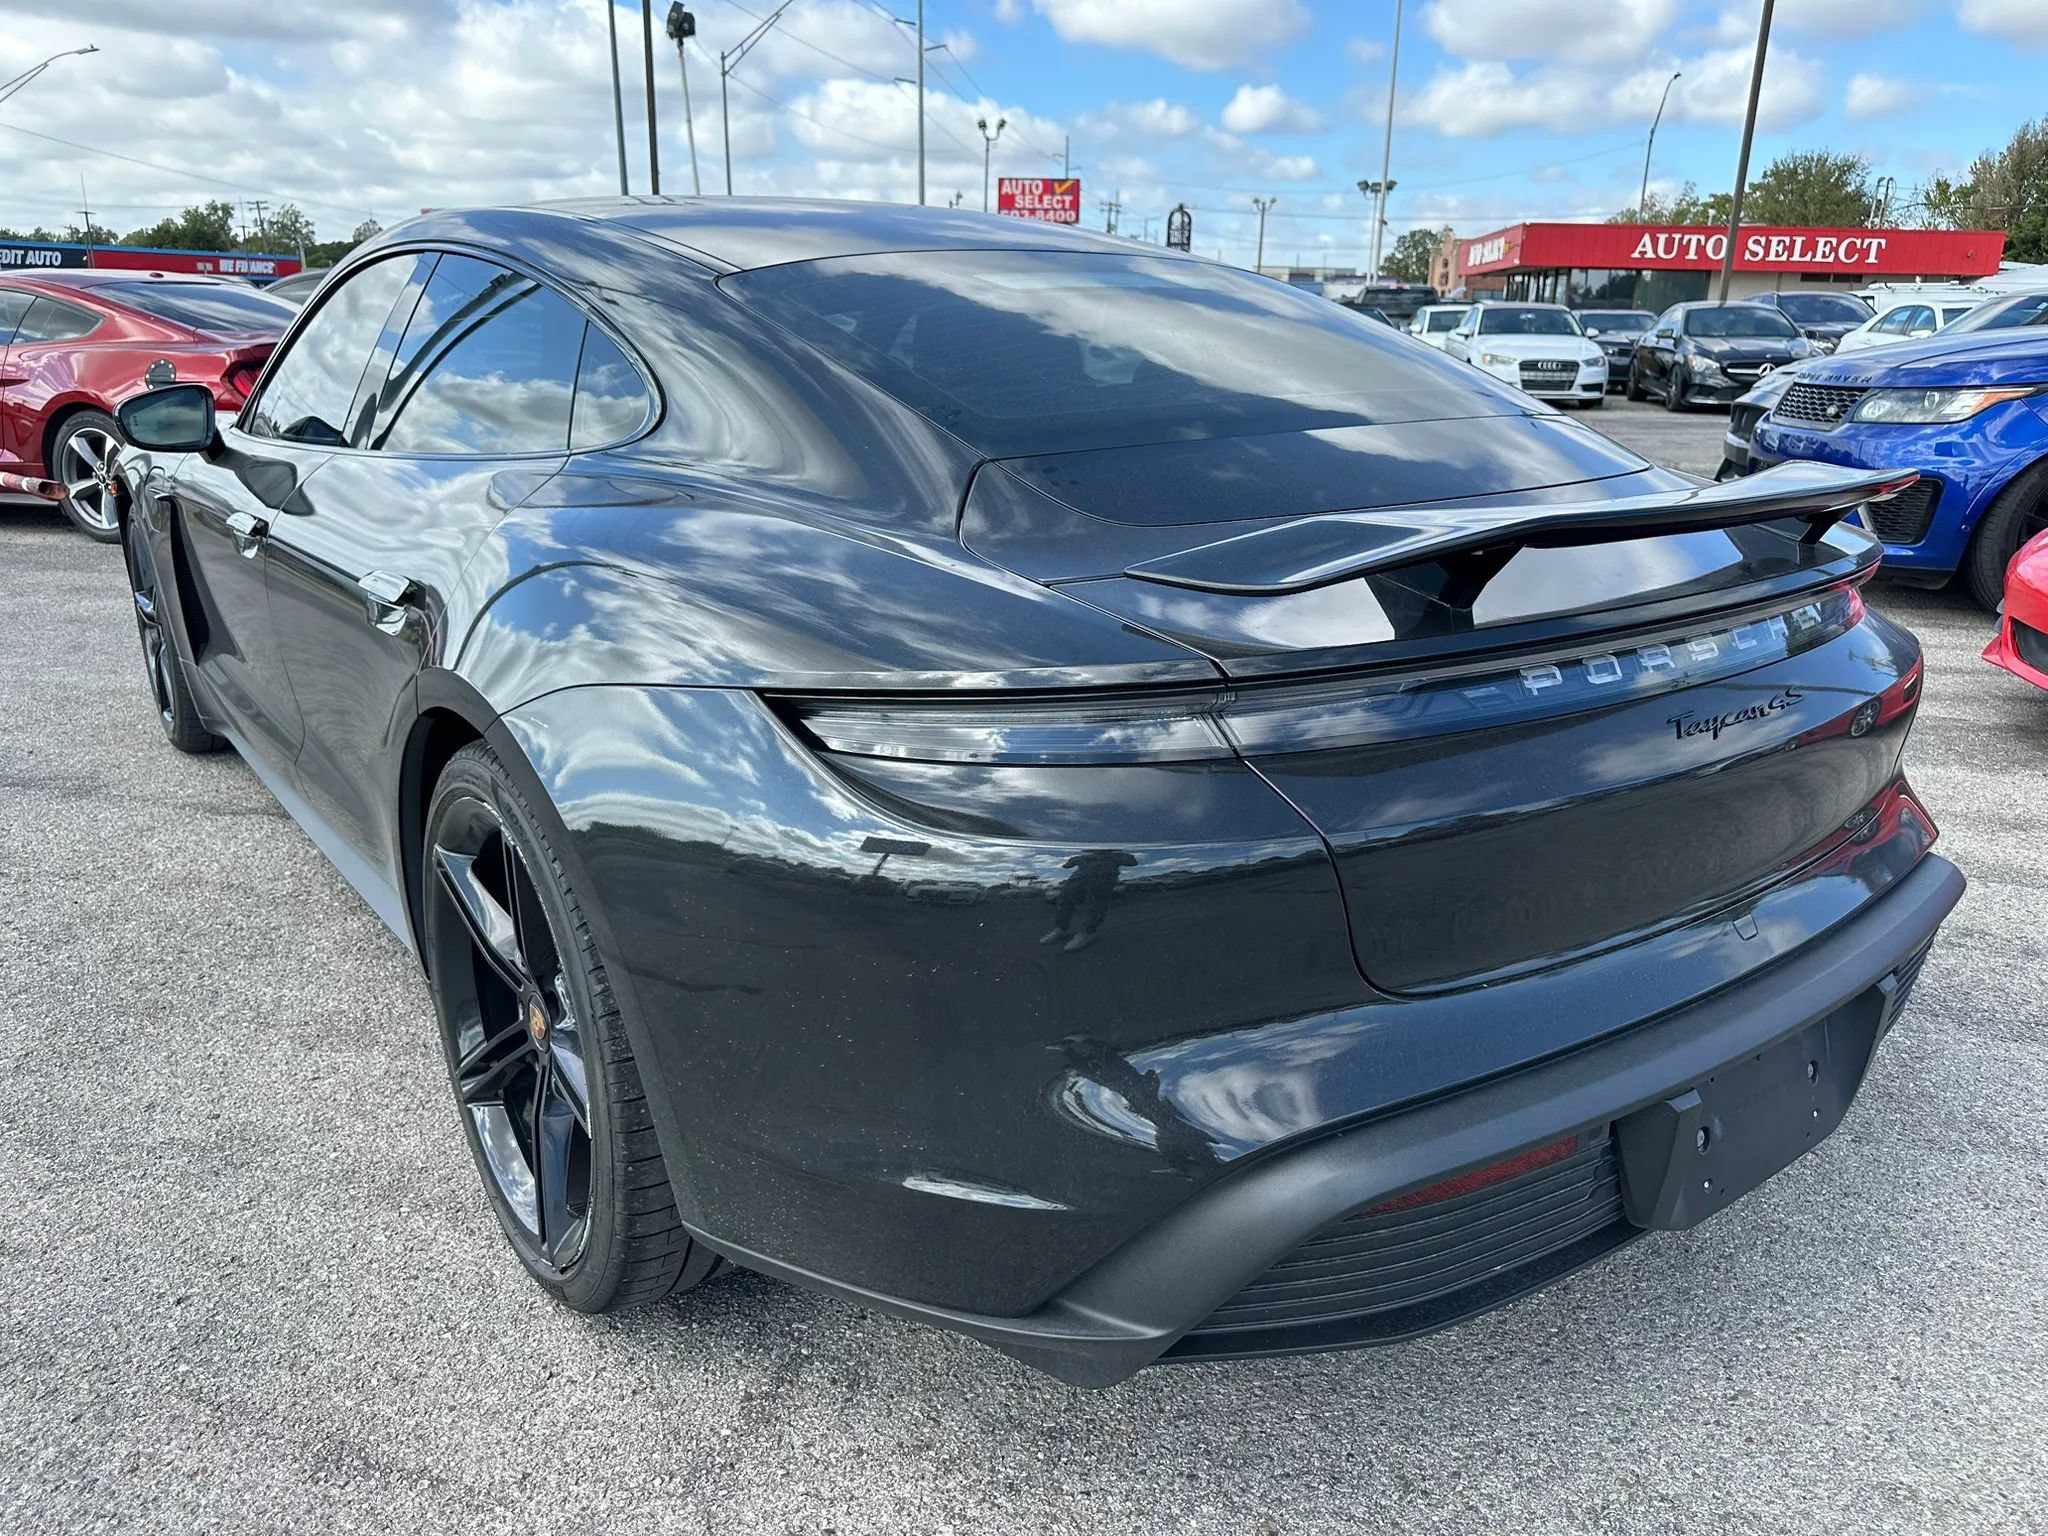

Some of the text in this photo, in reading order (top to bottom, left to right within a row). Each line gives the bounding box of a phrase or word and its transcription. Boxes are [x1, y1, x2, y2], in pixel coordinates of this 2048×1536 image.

[1001, 180, 1043, 195] AUTO
[1014, 195, 1073, 209] SELECT
[0, 248, 62, 266] DIT AUTO
[1630, 232, 1886, 264] AUTO SELECT
[1519, 601, 1822, 696] PORSCHE
[1666, 703, 1771, 740] Taycan
